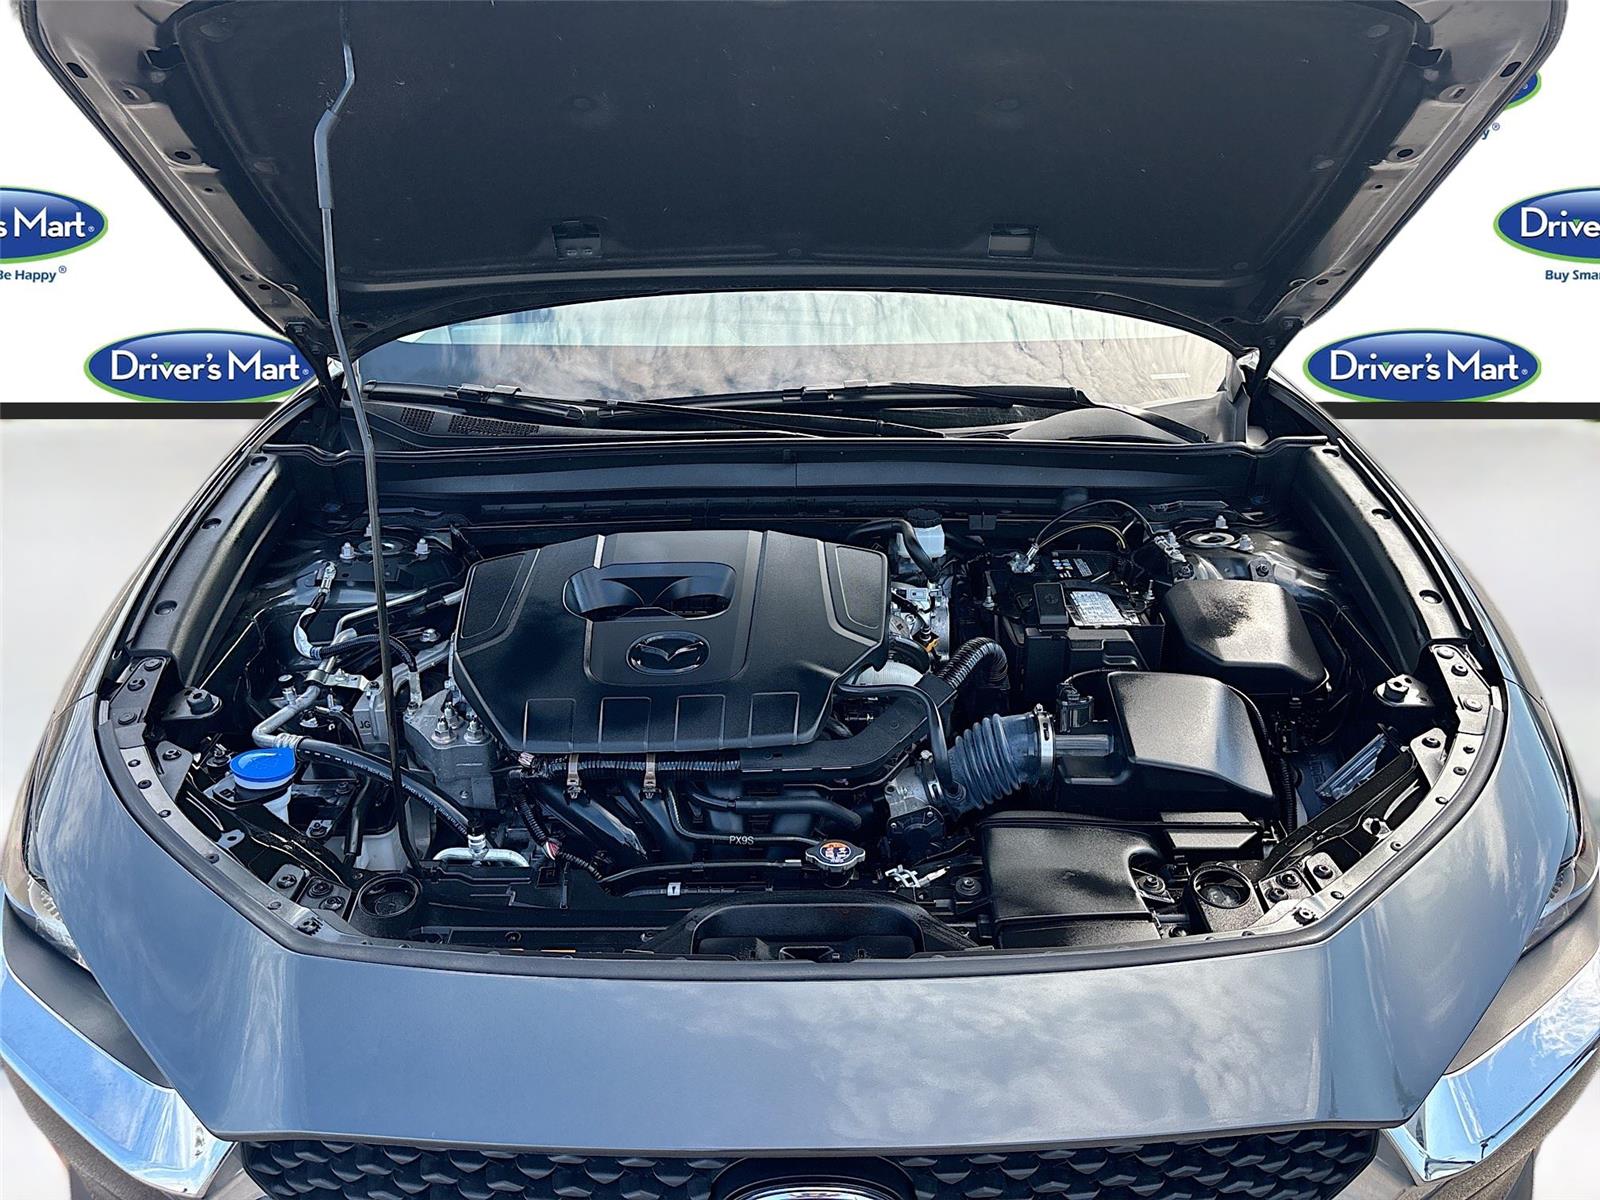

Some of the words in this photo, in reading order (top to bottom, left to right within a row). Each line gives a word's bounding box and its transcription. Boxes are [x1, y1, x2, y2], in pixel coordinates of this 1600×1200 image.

[14, 207, 86, 237] Mart
[15, 270, 57, 283] Happy
[1545, 270, 1570, 283] Buy
[111, 350, 222, 380] Driver's
[228, 350, 301, 380] Mart
[1330, 350, 1441, 380] Driver's
[1447, 350, 1520, 380] Mart
[729, 834, 755, 846] PX9S
